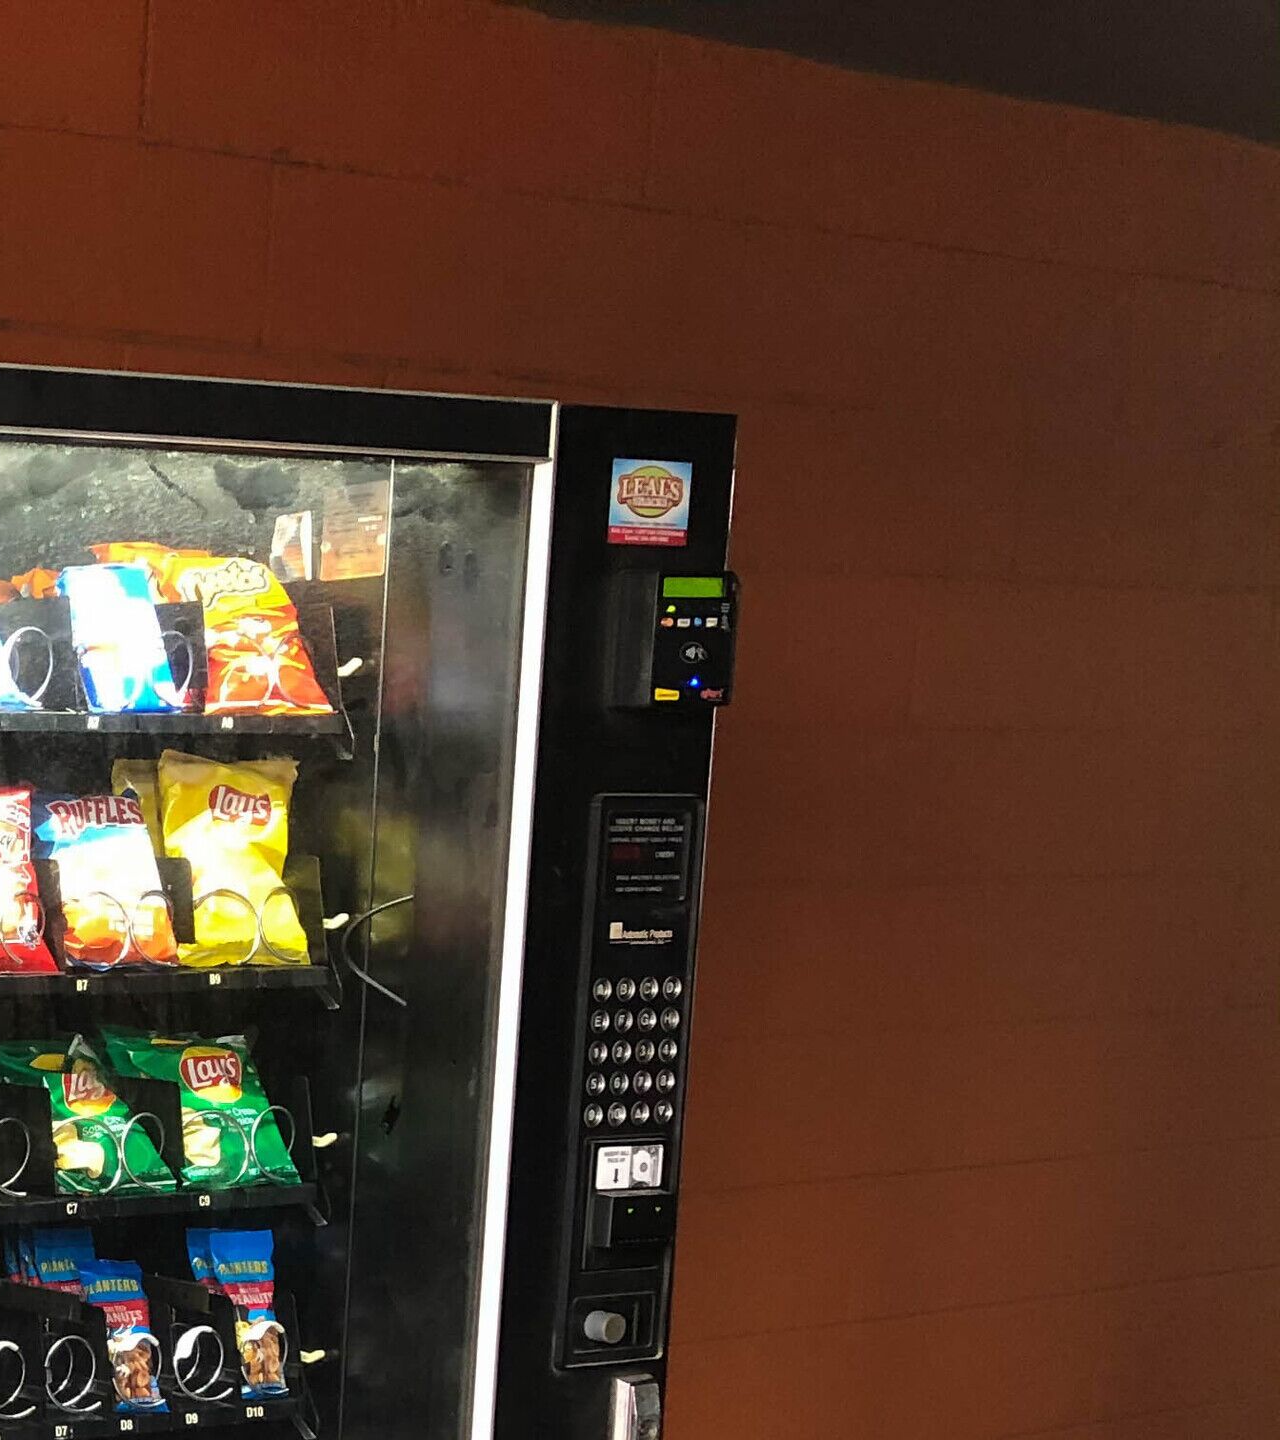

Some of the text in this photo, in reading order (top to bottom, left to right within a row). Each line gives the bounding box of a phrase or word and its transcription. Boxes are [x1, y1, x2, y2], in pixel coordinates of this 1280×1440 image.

[210, 785, 269, 825] Lay's
[48, 797, 145, 837] RUFFLES
[77, 979, 88, 992] B7
[209, 973, 221, 986] B9
[594, 1014, 602, 1028] E
[640, 1014, 649, 1027] G
[616, 1046, 623, 1058] 2
[186, 1055, 237, 1089] Lay's
[590, 1077, 597, 1090] 5
[613, 1076, 621, 1089] 6
[198, 1195, 211, 1207] C9
[66, 1202, 78, 1216] C7
[185, 1412, 199, 1426] D9
[245, 1405, 265, 1419] D10
[54, 1424, 68, 1438] D7
[119, 1418, 134, 1432] D8
